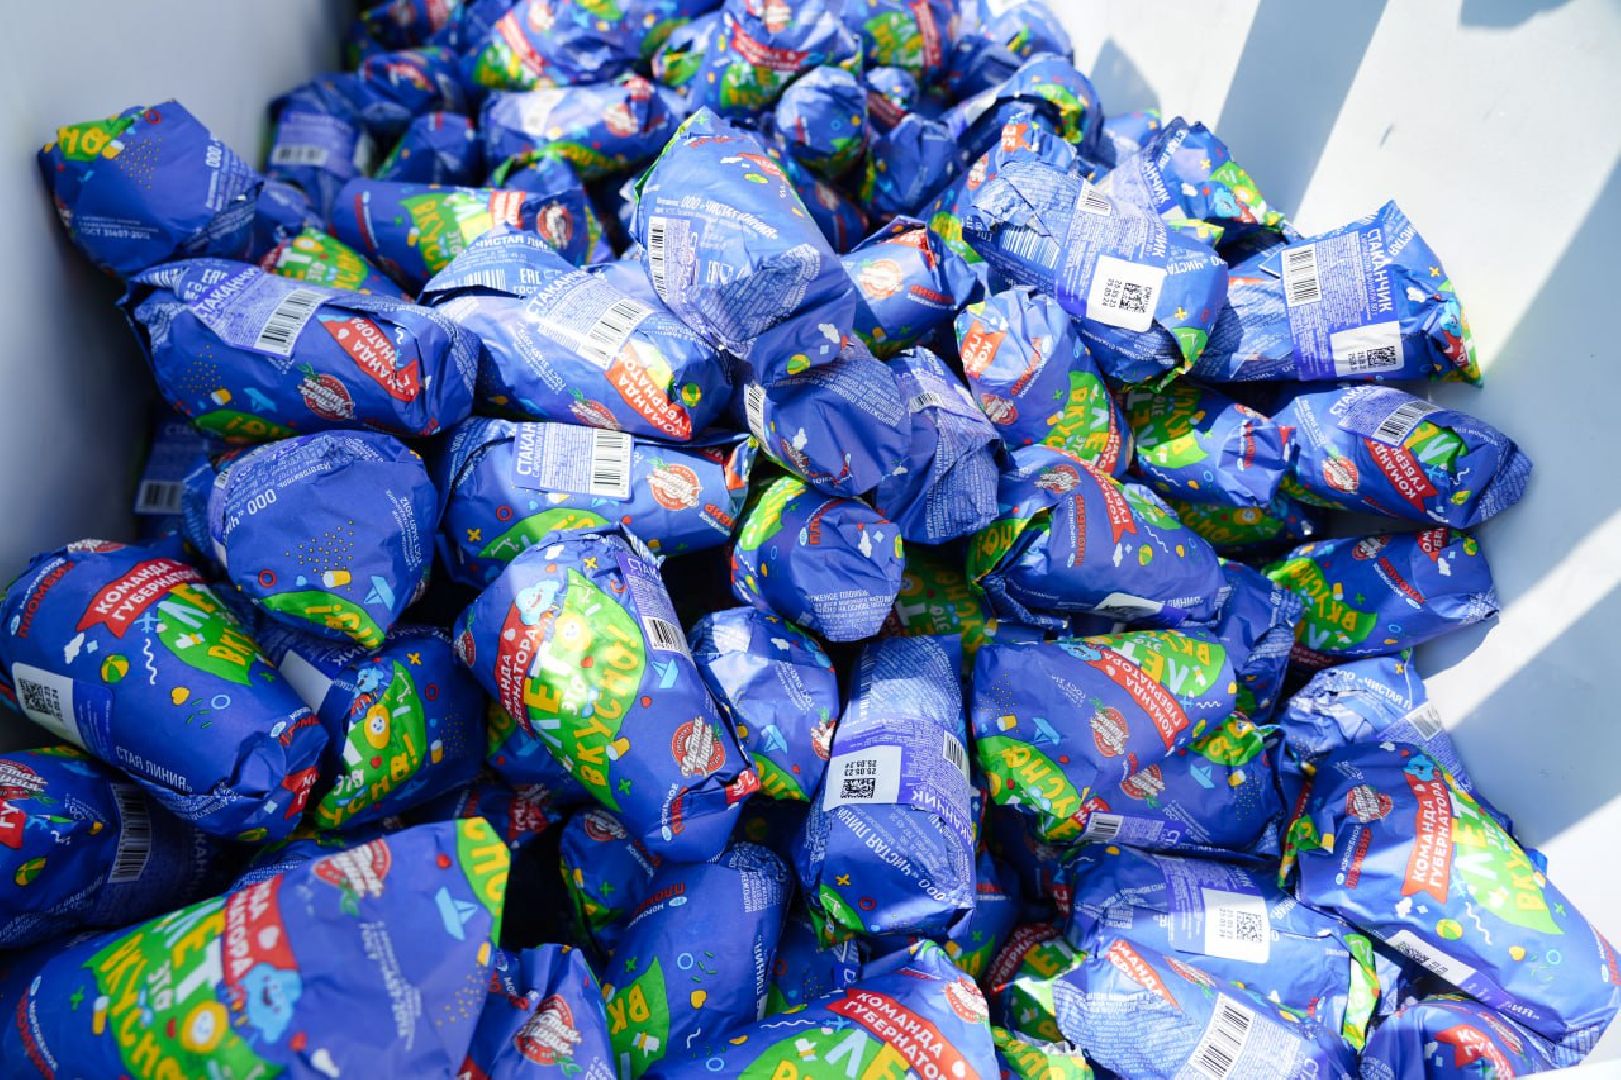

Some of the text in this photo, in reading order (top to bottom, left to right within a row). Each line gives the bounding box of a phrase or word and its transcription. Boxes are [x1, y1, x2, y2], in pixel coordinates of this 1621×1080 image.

[1366, 228, 1394, 313] СТАКАНЧИК
[618, 373, 682, 437] КОМАНДА
[516, 422, 537, 475] СТАКАН
[246, 487, 279, 516] ООО
[94, 560, 173, 615] КОМАНДА
[573, 623, 640, 786] ВКУСНО!
[1103, 651, 1184, 728] ГУБЕРНАТОРА
[1124, 675, 1175, 739] КОМАНДА
[1411, 799, 1434, 882] КОМАНДА
[1427, 781, 1449, 888] ГУБЕРНАТОРА
[856, 991, 946, 1058] КОМАНДА
